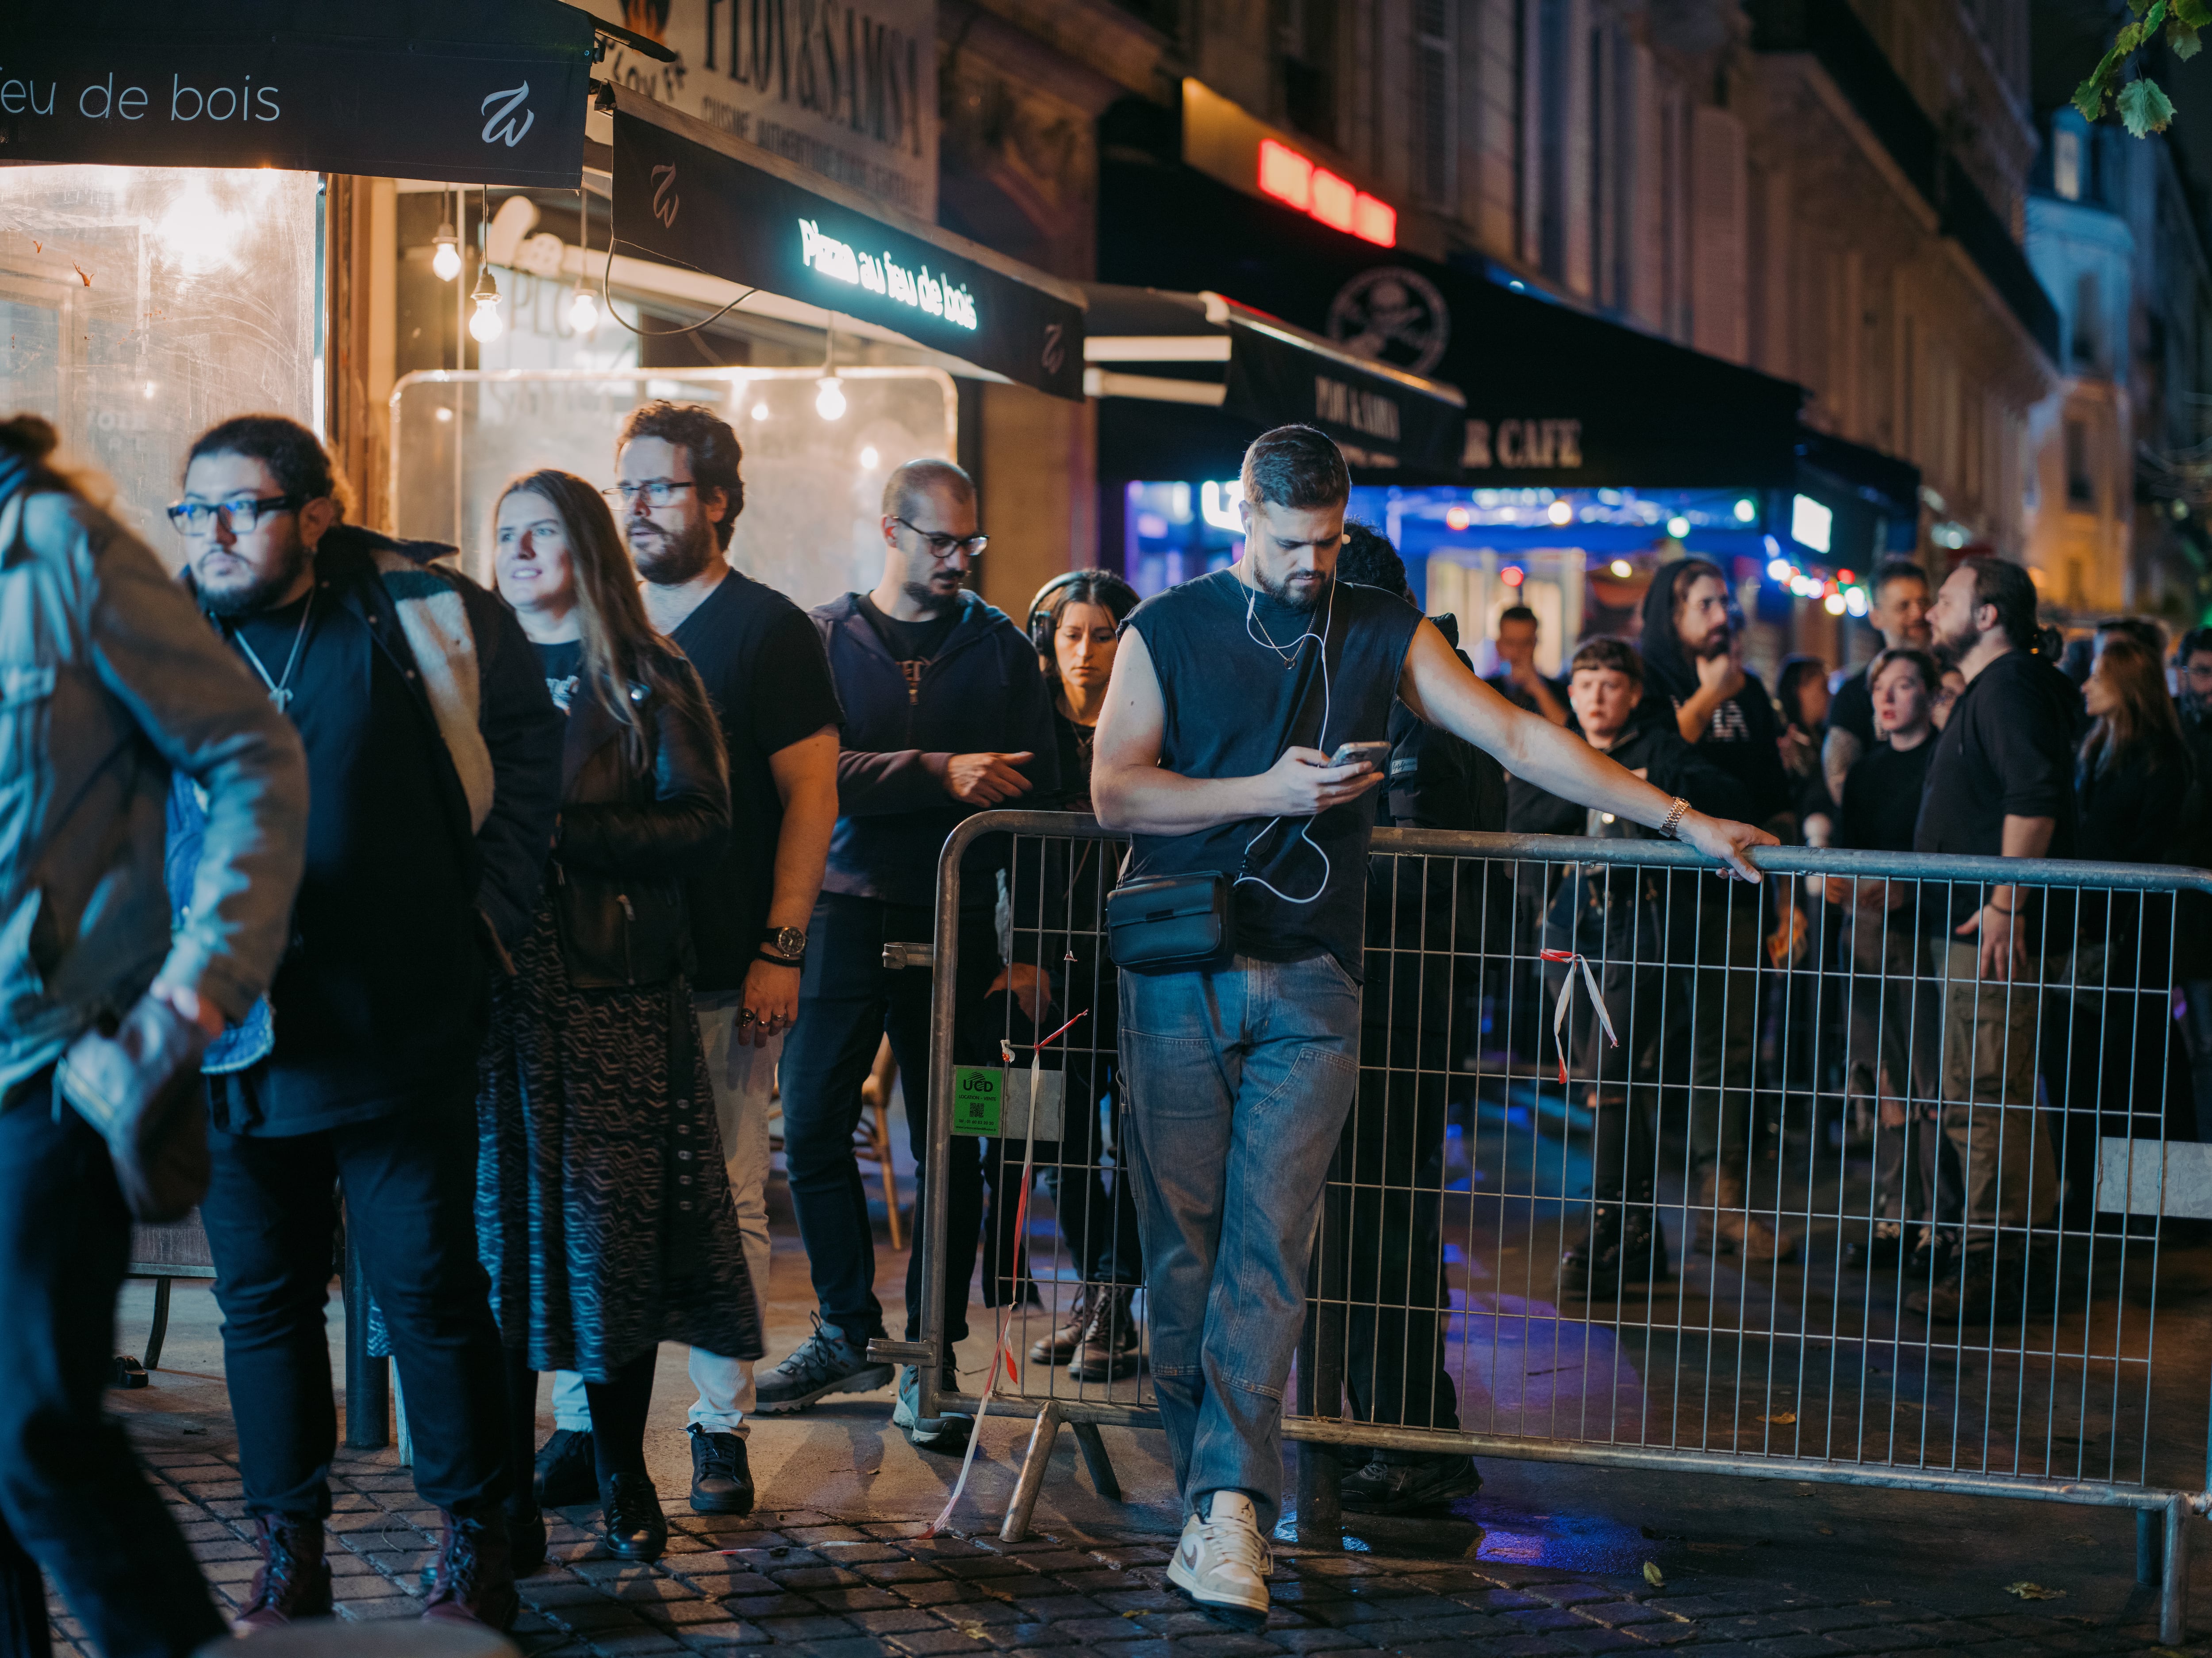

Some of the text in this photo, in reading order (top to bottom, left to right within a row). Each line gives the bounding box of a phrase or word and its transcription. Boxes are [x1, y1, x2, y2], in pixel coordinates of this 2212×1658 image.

[0, 67, 280, 121] eu de bois
[858, 251, 885, 295] au
[883, 251, 918, 306] feu
[918, 265, 943, 316] de
[940, 272, 977, 330] bois
[963, 1079, 993, 1092] UCD
